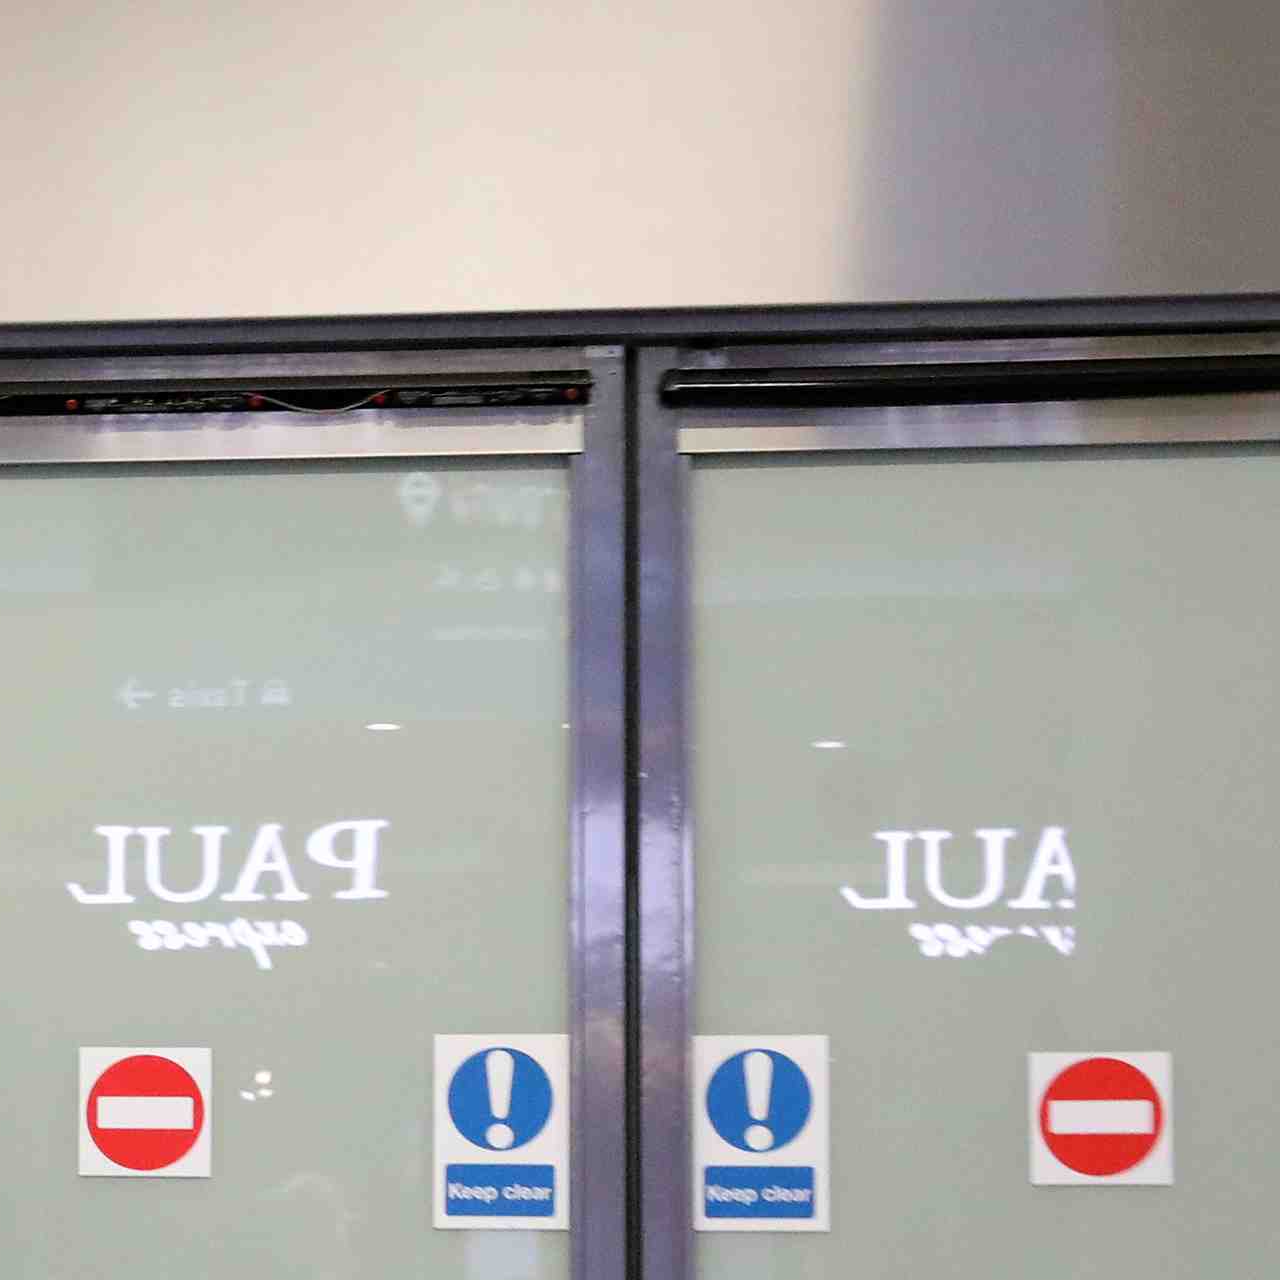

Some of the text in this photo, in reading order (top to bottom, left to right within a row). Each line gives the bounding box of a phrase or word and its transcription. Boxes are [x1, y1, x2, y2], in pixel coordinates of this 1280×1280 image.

[446, 1182, 554, 1204] Keep clear
[704, 1184, 812, 1206] Keep clear
